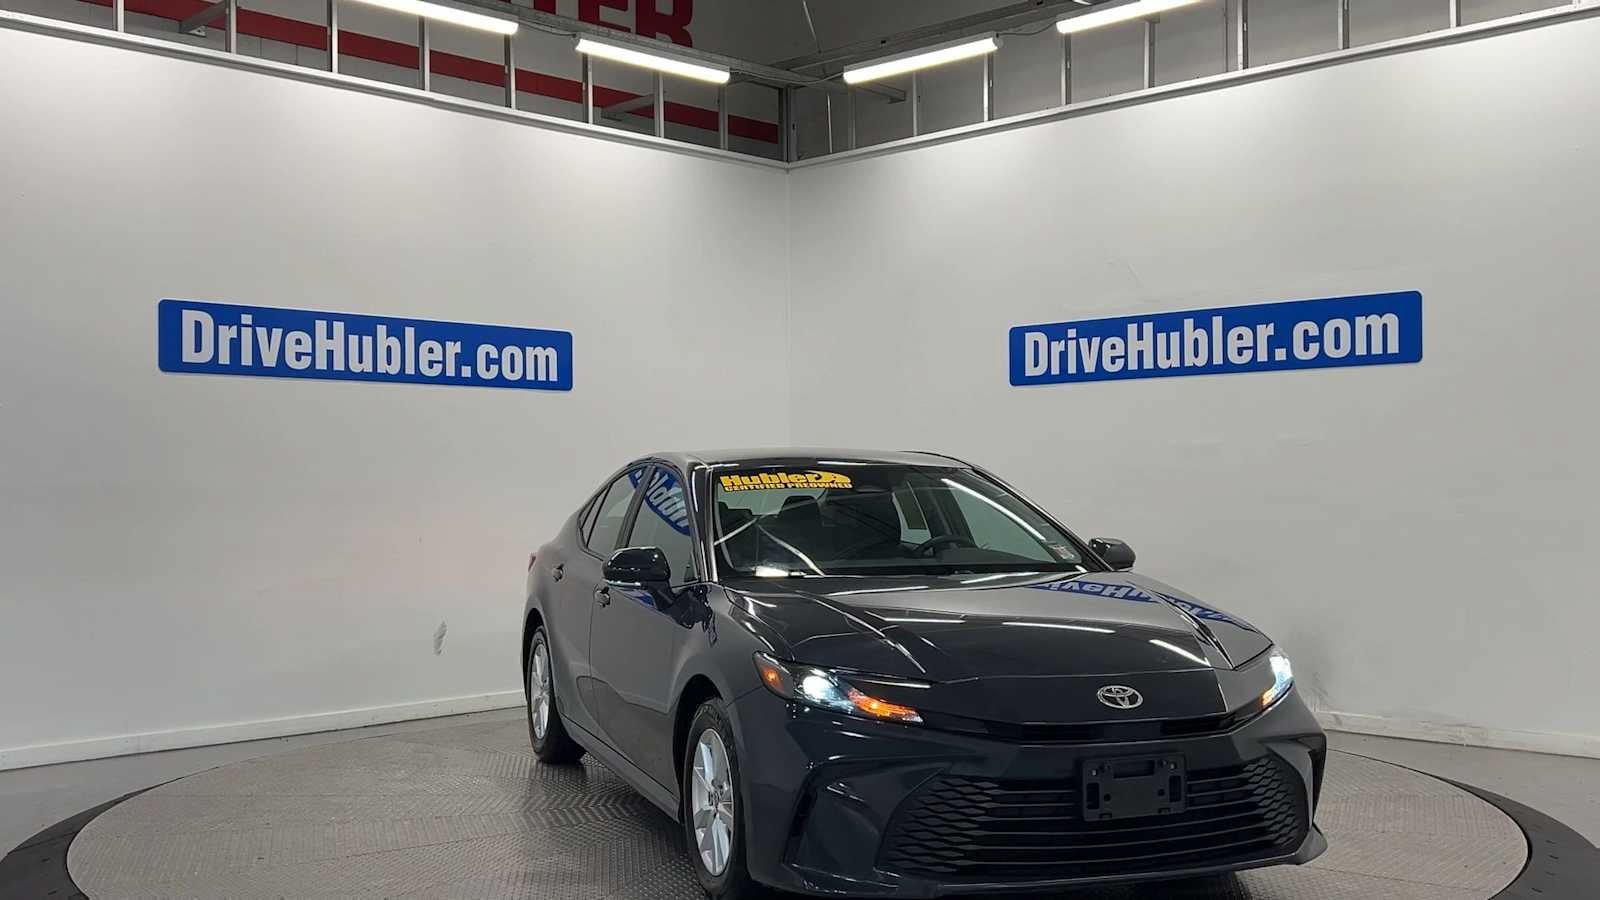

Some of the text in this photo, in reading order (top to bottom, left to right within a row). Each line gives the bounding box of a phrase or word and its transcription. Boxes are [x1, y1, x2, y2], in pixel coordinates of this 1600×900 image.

[181, 309, 558, 382] DriveHubler.com
[1024, 313, 1400, 377] DriveHubler.com
[720, 472, 821, 487] Hubler
